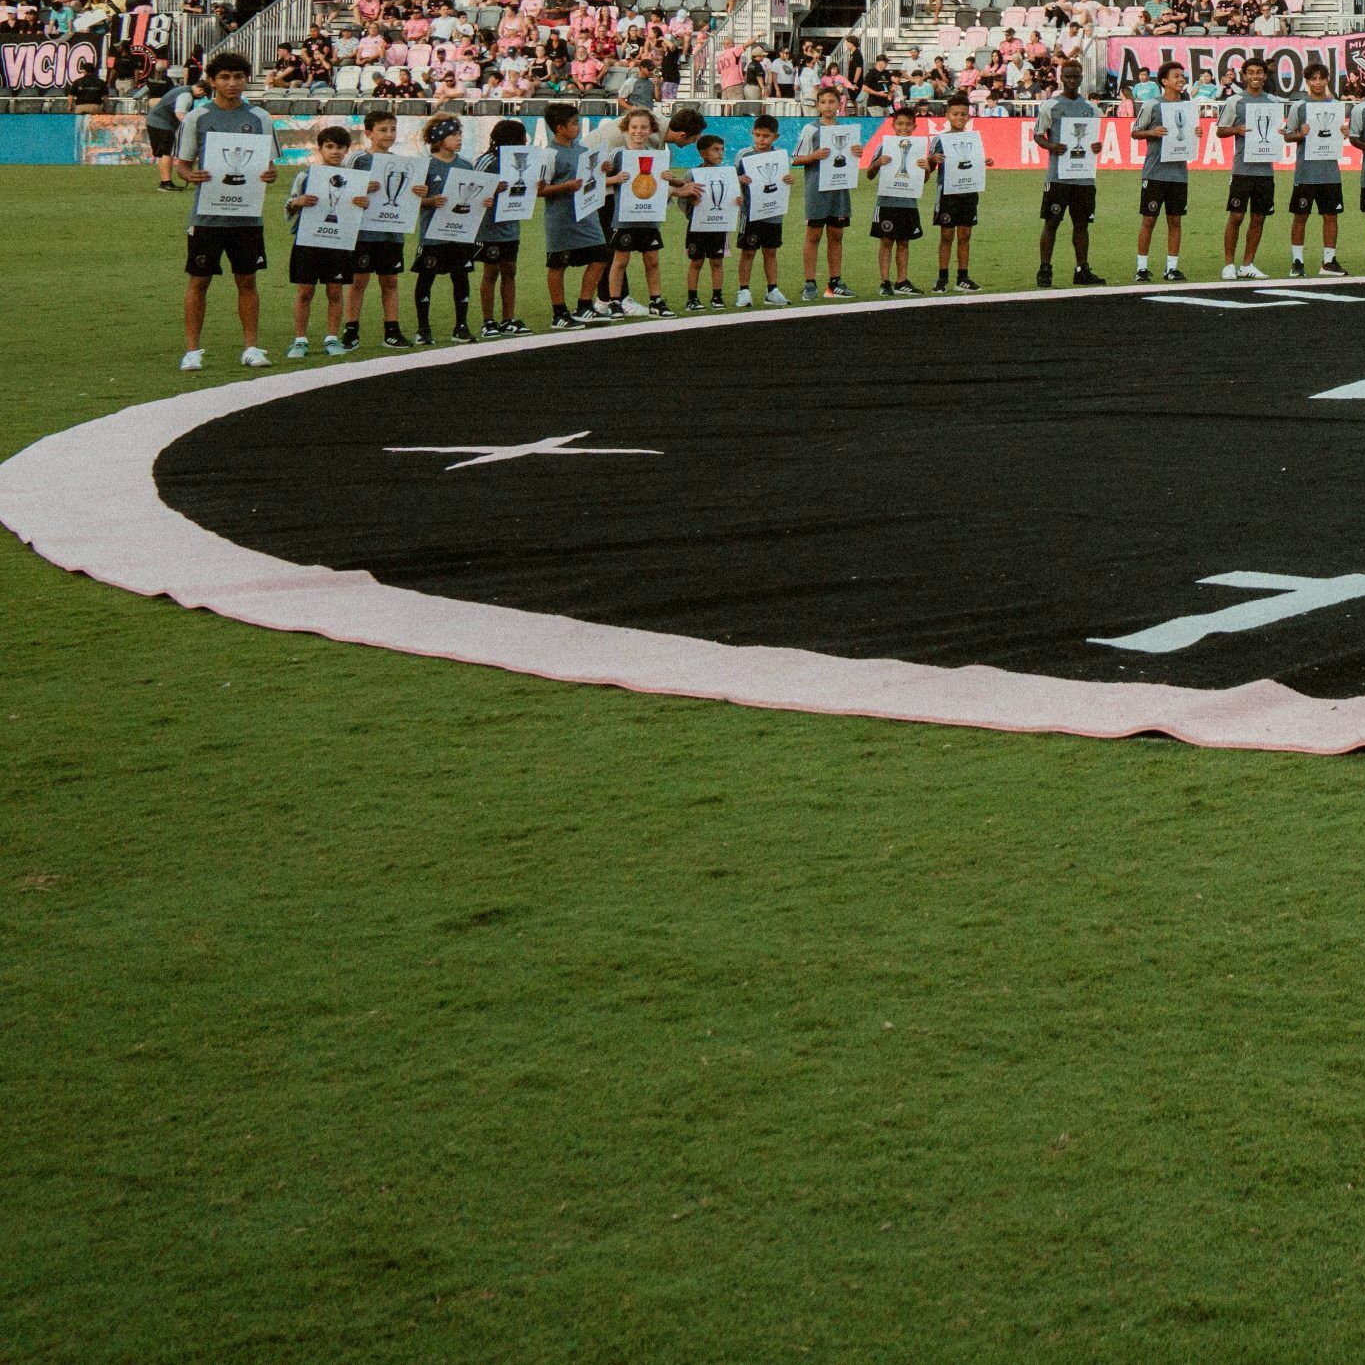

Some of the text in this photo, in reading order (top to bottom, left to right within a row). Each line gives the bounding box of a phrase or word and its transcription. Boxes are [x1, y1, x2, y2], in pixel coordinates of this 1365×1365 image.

[718, 58, 730, 71] 10
[1021, 121, 1148, 165] RAL
[762, 200, 777, 208] 2009
[378, 212, 399, 220] 2006
[445, 222, 463, 230] 2006
[316, 226, 338, 235] 2005
